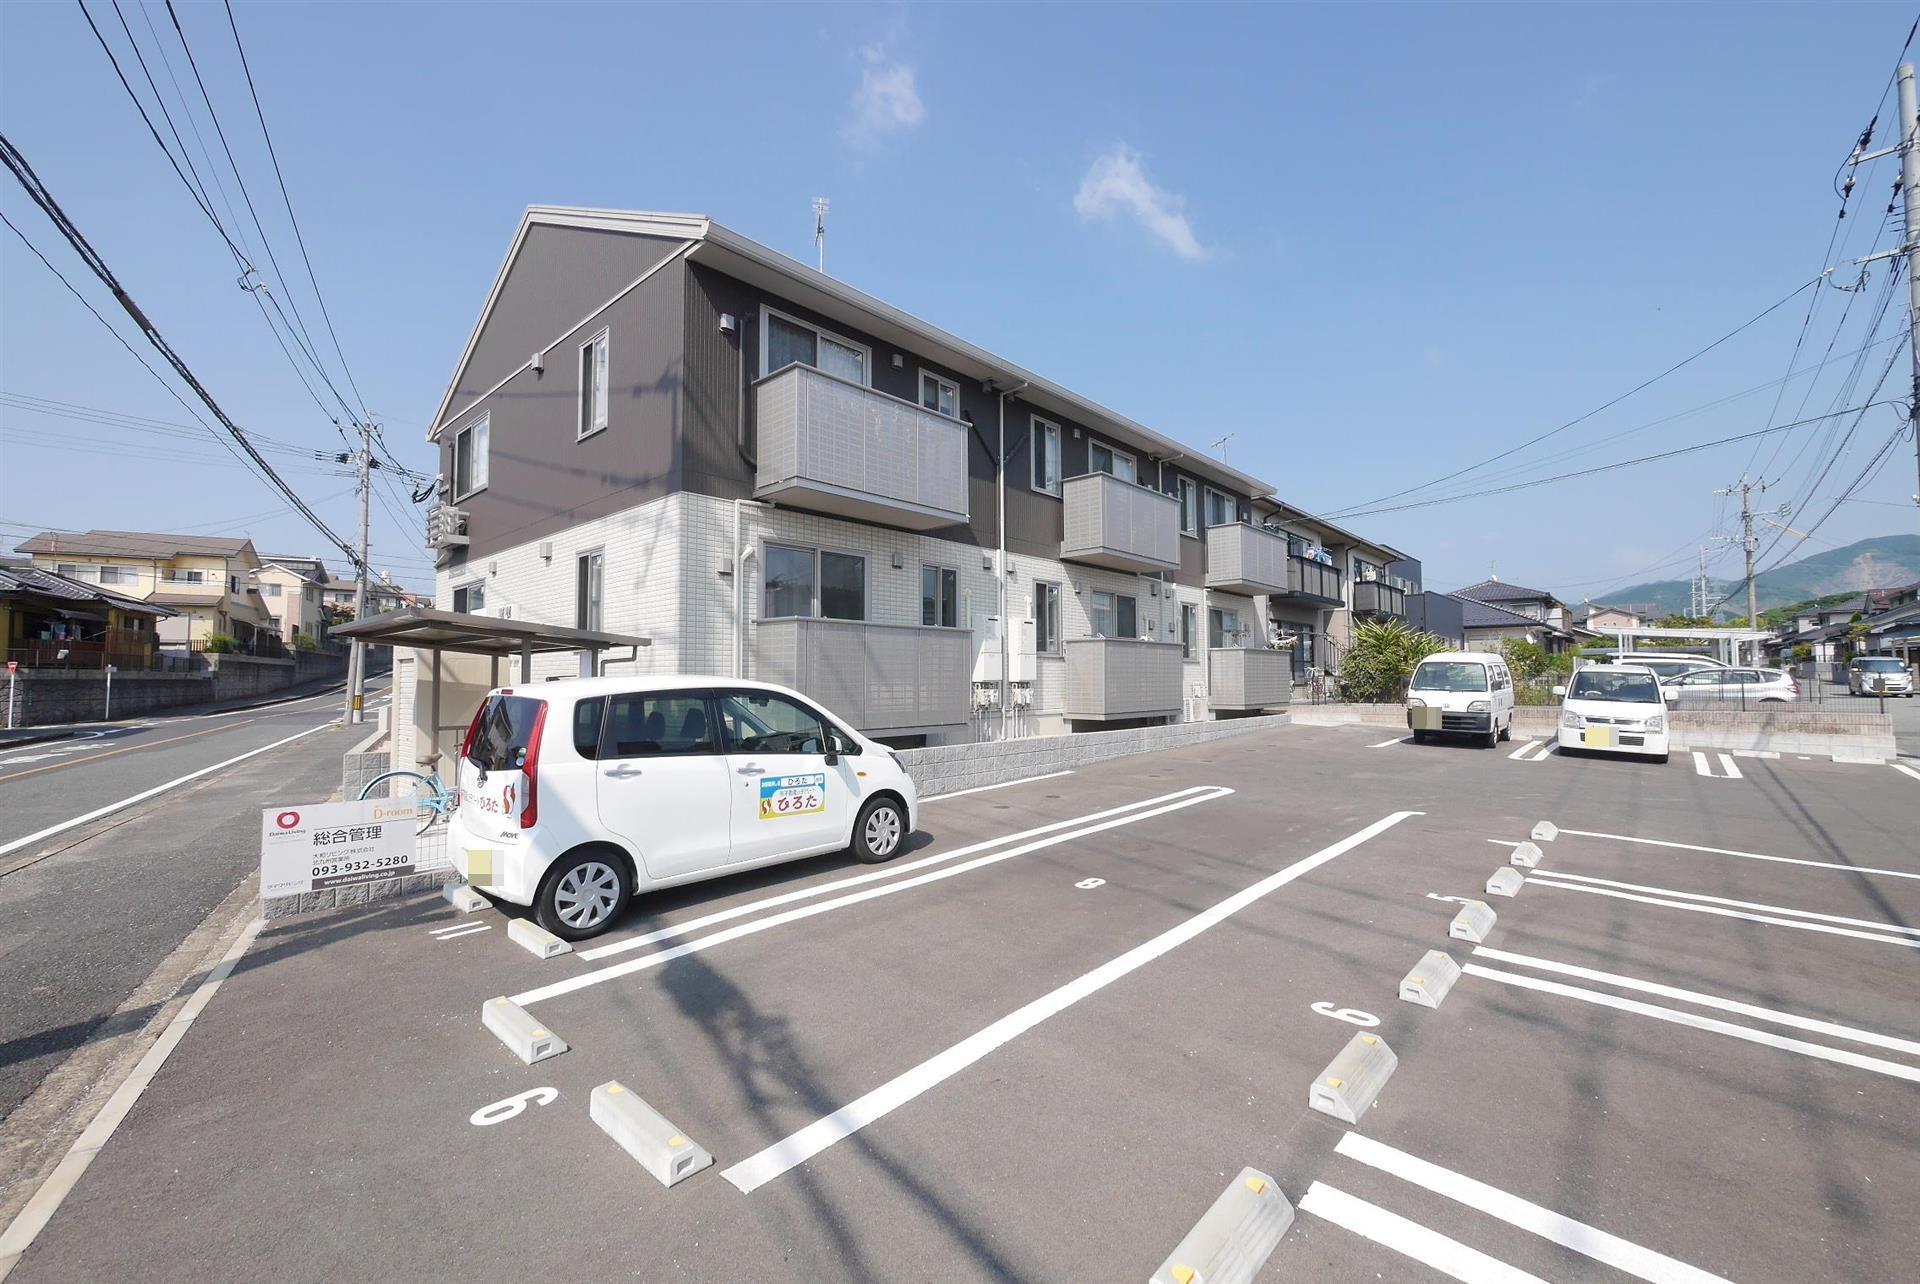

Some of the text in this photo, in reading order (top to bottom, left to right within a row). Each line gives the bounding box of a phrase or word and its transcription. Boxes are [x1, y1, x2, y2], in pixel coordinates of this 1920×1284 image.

[788, 777, 808, 785] ひろた
[479, 796, 499, 813] ひろた
[777, 794, 817, 811] ひろた
[374, 808, 413, 819] D-room
[313, 826, 382, 846] 総合管理
[500, 831, 519, 839] MOVE
[312, 855, 408, 876] 093-932-5280
[324, 871, 396, 885] www.daiwaliving.co.jp
[1074, 877, 1106, 889] 8
